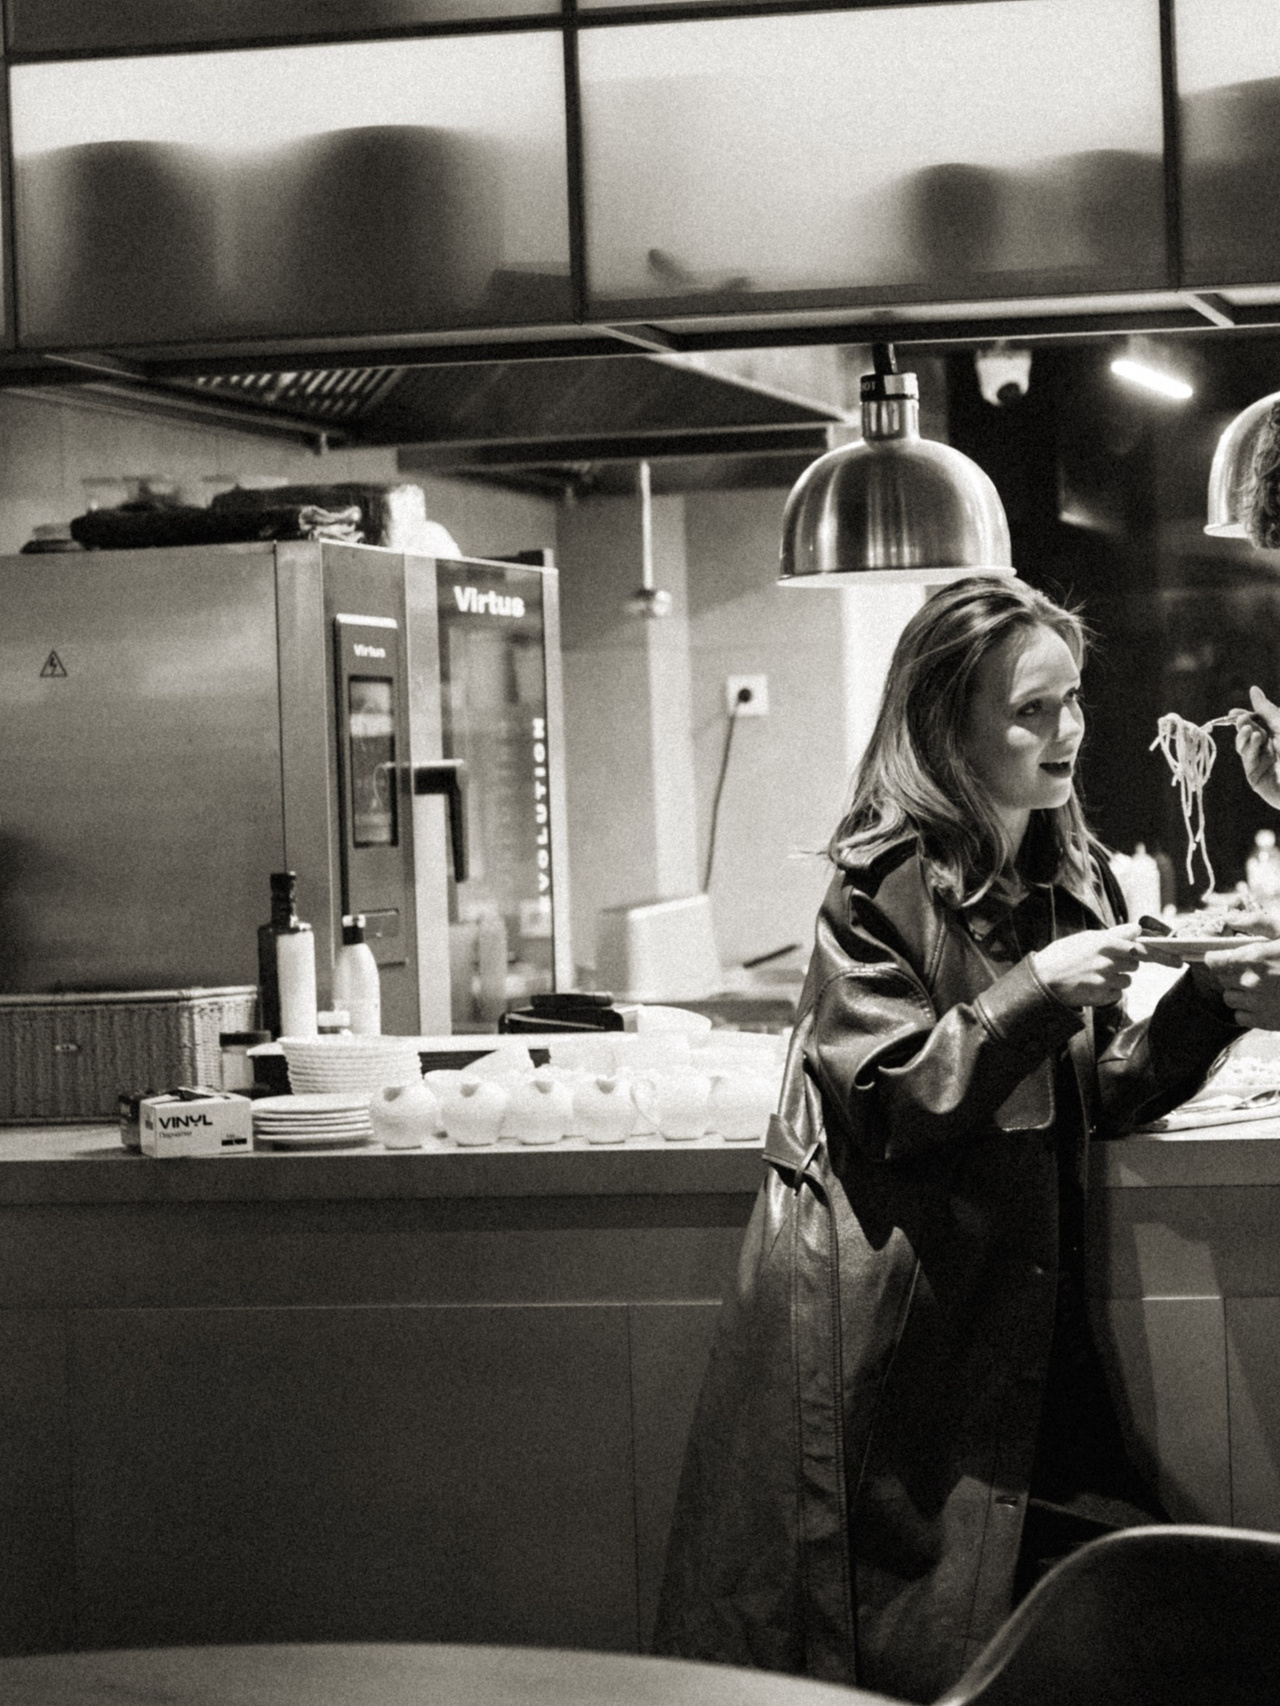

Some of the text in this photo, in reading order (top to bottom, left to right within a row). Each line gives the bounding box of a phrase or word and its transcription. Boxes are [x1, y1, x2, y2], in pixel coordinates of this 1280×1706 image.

[453, 585, 526, 618] Virtus
[353, 643, 386, 658] Virtus
[158, 1114, 214, 1130] VINYL
